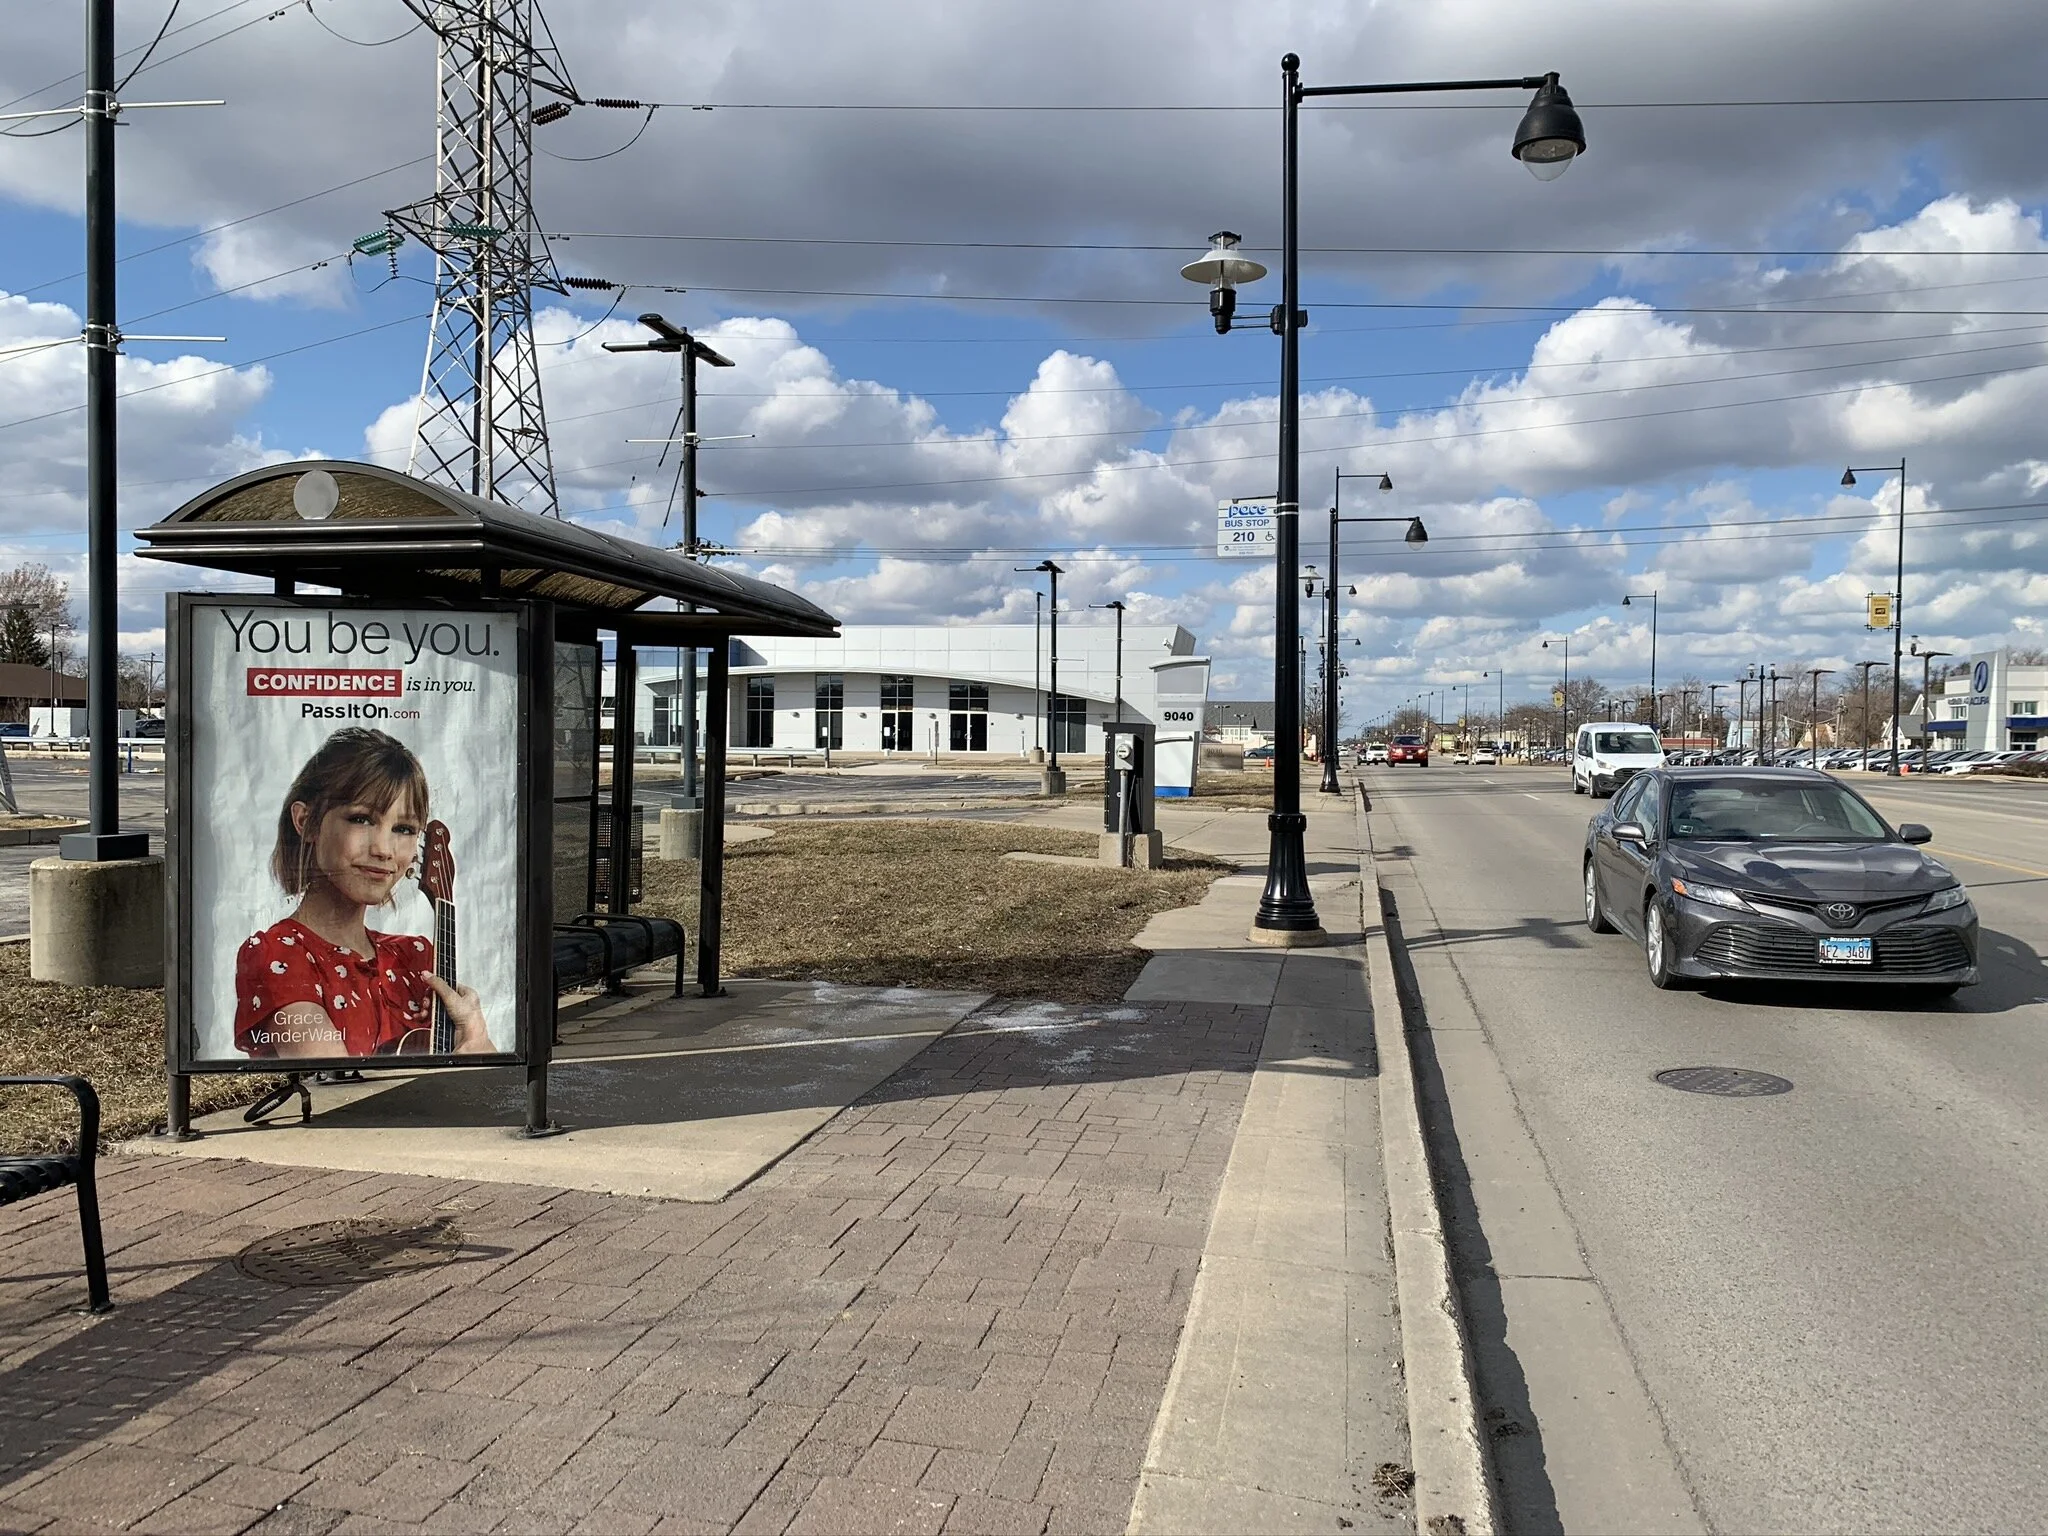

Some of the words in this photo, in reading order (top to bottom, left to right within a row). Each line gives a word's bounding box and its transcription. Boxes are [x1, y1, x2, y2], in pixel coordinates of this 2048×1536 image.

[1229, 505, 1267, 518] pace
[1233, 532, 1255, 542] 210
[220, 609, 311, 653] You
[328, 611, 390, 654] be
[403, 622, 500, 665] you.
[253, 674, 396, 691] CONFIDENCE
[406, 677, 421, 691] is
[424, 677, 441, 692] in
[444, 681, 476, 698] you.
[1164, 711, 1194, 721] 9040
[1846, 945, 1870, 958] 3487
[274, 1011, 324, 1025] Grace
[250, 1027, 346, 1044] VanderWaal
